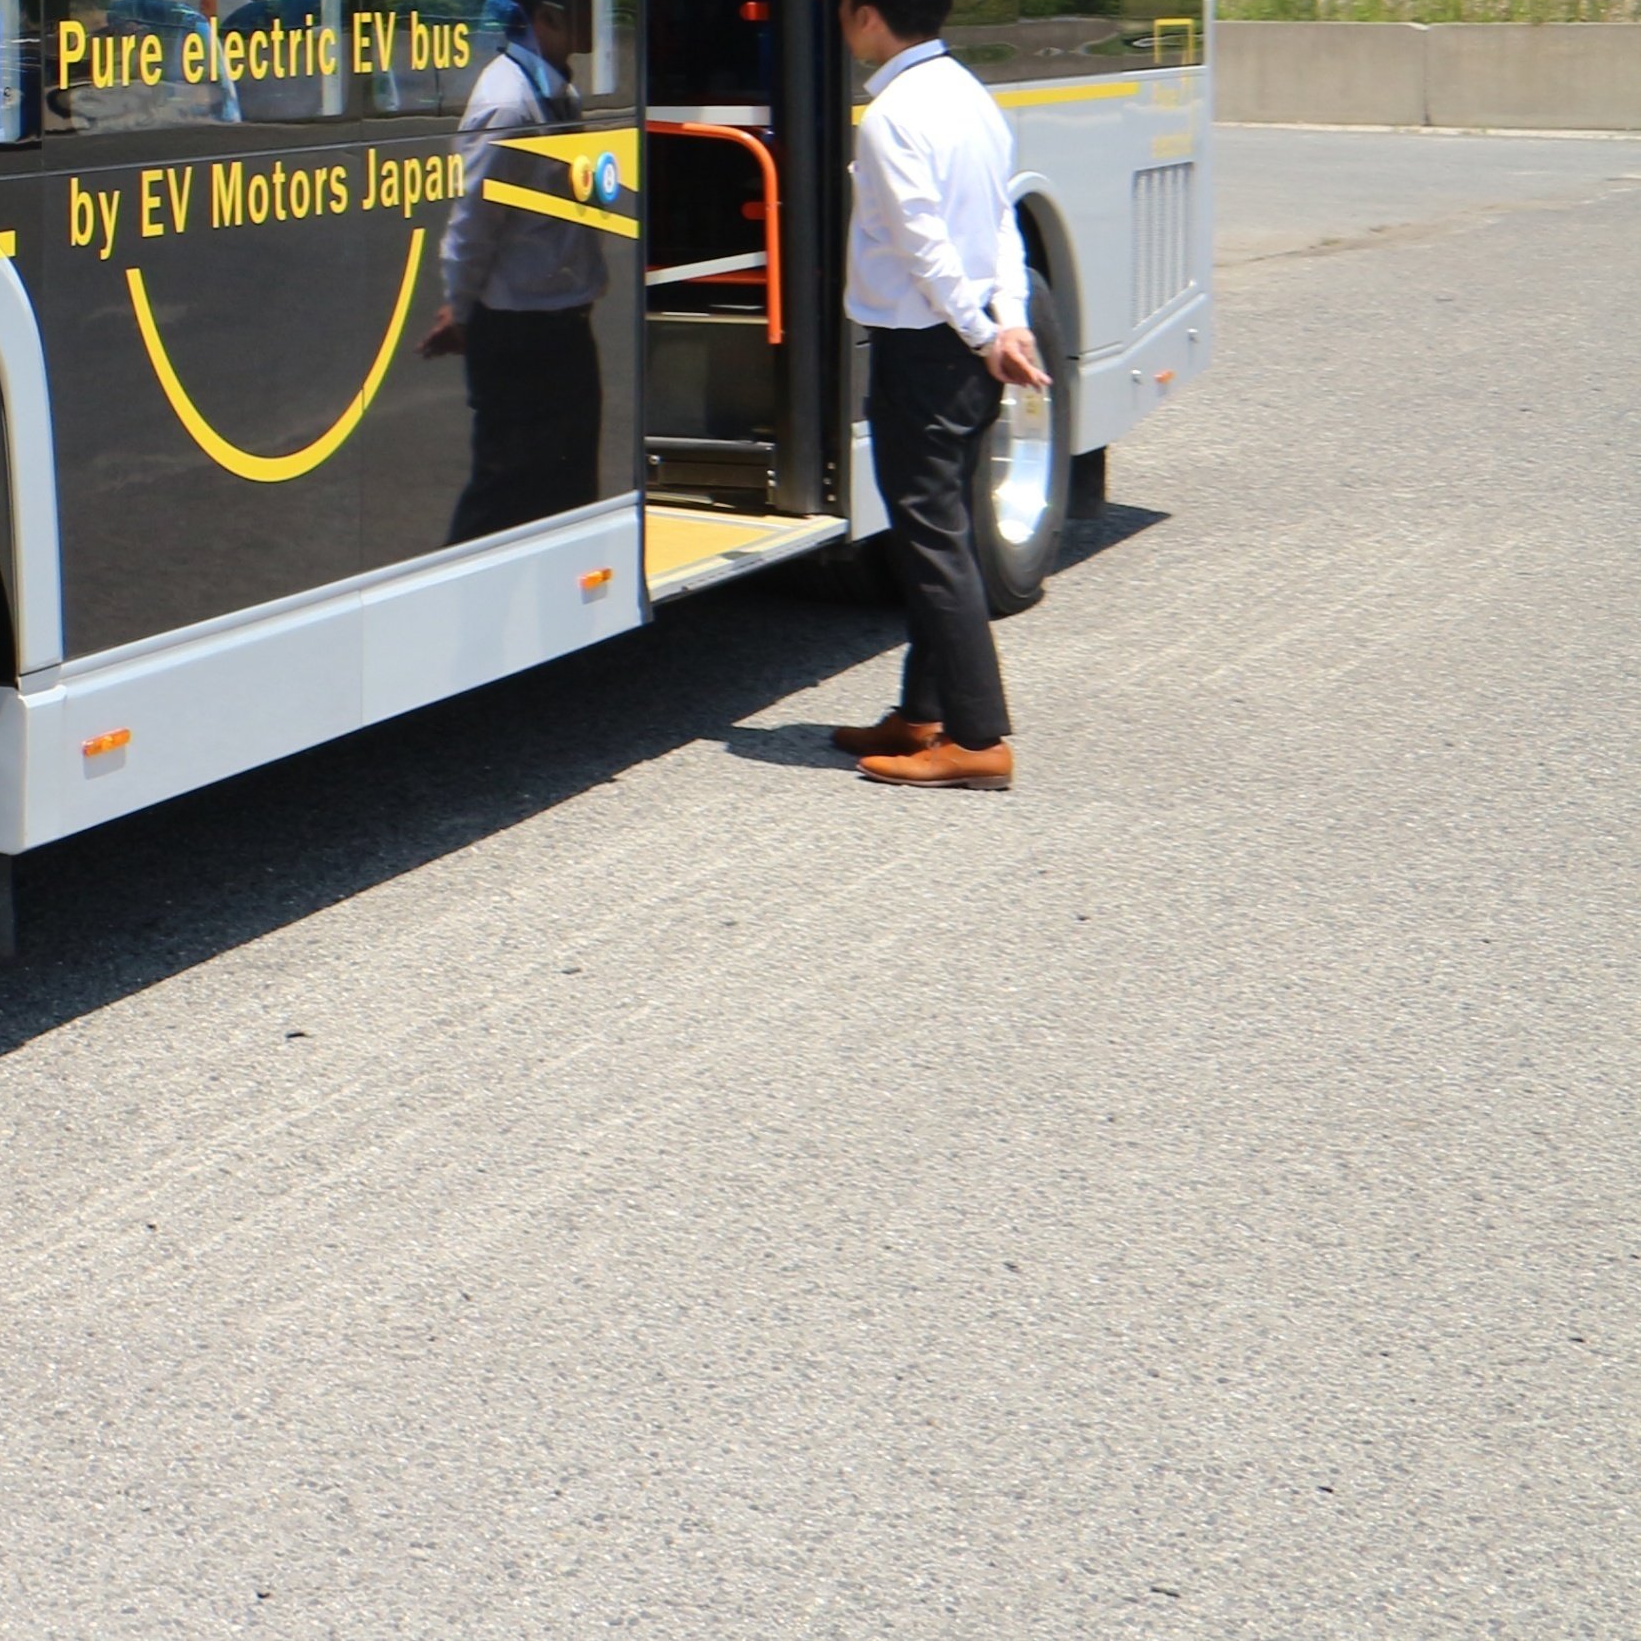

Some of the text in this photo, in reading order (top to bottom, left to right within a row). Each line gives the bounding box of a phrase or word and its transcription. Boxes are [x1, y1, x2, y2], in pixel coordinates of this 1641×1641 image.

[58, 11, 470, 90] Pure electric EV bus
[69, 147, 465, 260] by EV Motors Japan
